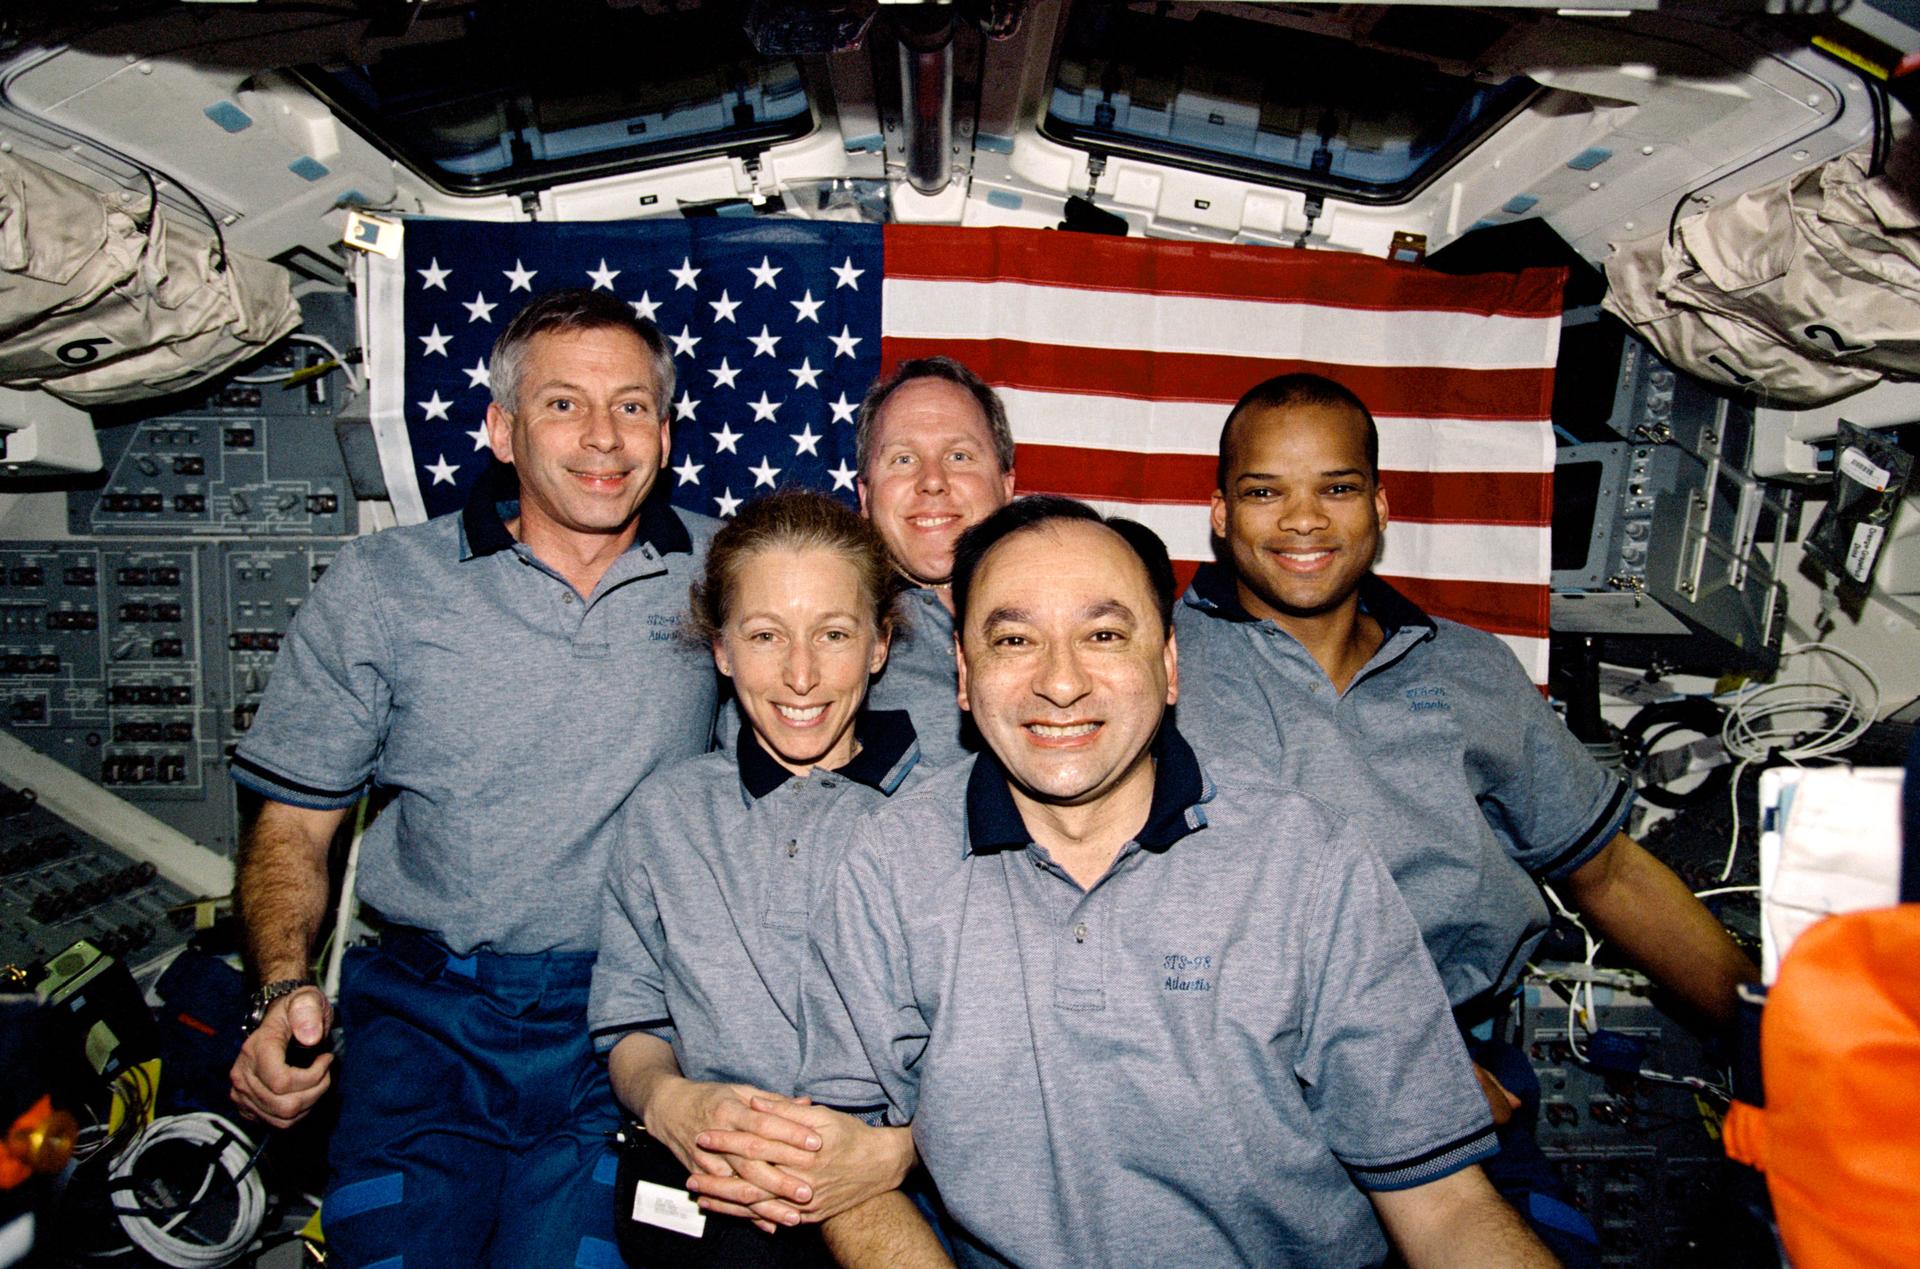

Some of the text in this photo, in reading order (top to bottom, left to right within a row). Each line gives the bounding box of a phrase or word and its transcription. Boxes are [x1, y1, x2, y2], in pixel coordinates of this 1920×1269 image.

[1804, 324, 1866, 351] 2
[1163, 955, 1212, 970] STS-98
[1164, 977, 1212, 991] Atlantis
